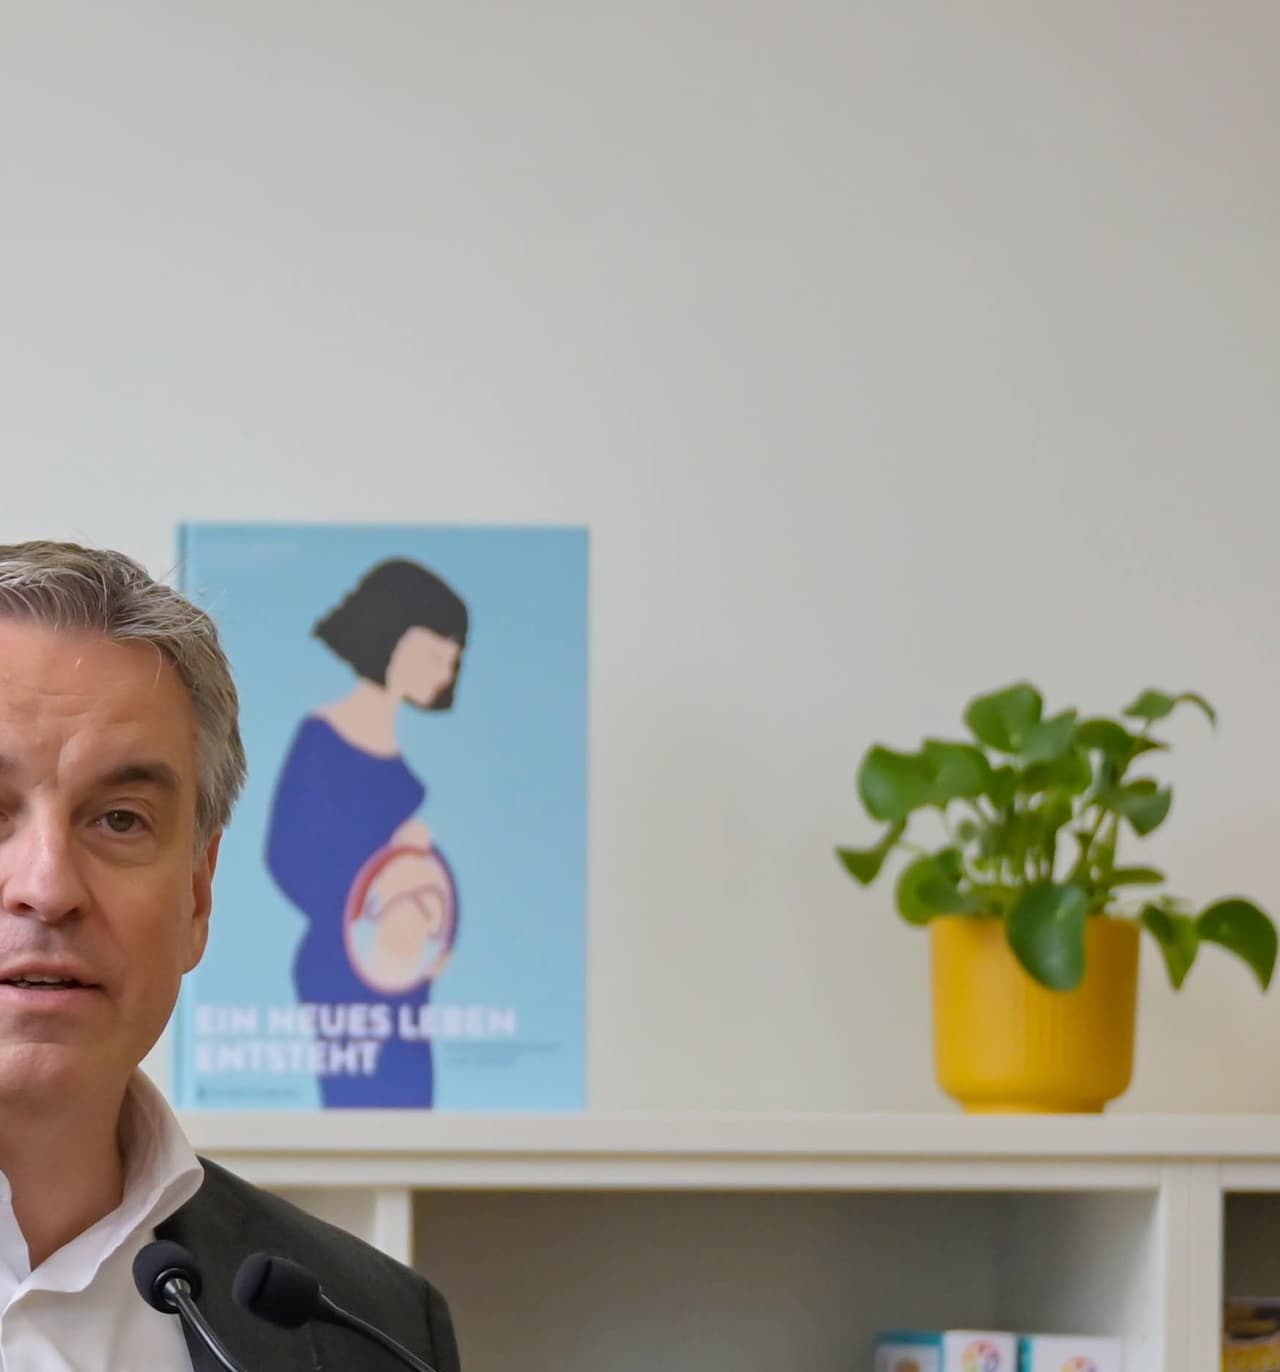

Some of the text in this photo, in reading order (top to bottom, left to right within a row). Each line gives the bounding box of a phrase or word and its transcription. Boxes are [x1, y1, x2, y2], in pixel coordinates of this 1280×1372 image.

[196, 1005, 517, 1038] EIN NEUES LEBEN
[196, 1040, 382, 1074] ENTSTEHT
